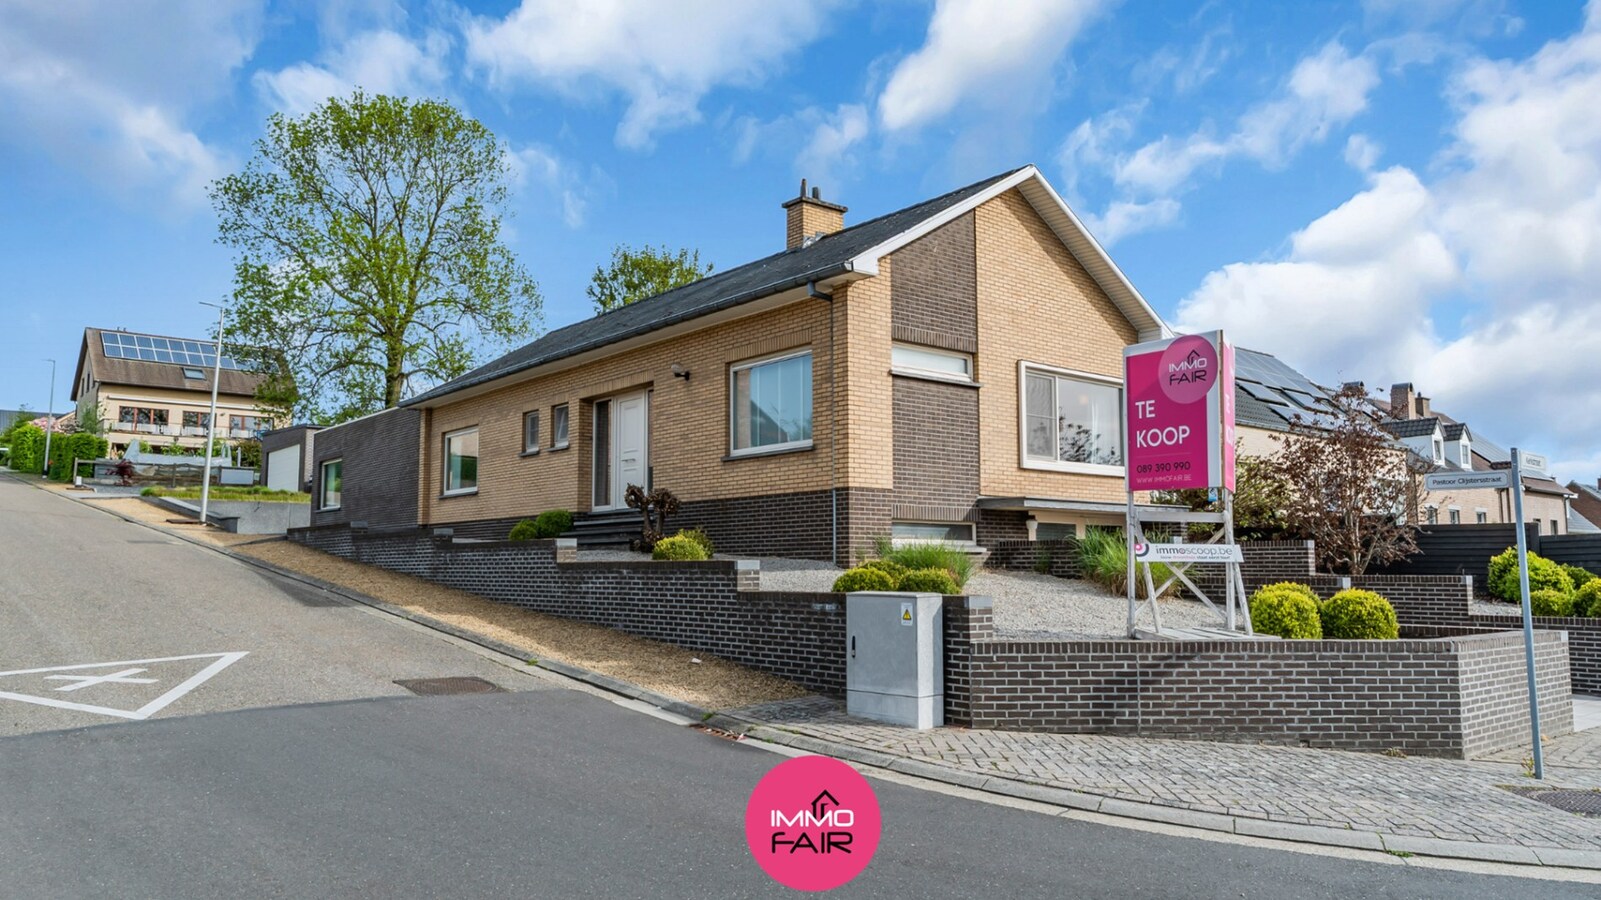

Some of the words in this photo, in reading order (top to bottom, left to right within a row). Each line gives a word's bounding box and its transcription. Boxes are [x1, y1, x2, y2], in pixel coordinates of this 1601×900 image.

[1168, 357, 1208, 373] IMMO
[1169, 369, 1208, 386] FAIR
[1135, 399, 1156, 419] TE
[1136, 425, 1191, 449] KOOP
[1136, 463, 1153, 474] 089
[1155, 462, 1172, 473] 390
[1173, 461, 1191, 471] 990
[1432, 478, 1456, 486] Pastoor
[1155, 545, 1233, 556] immoscoop.be
